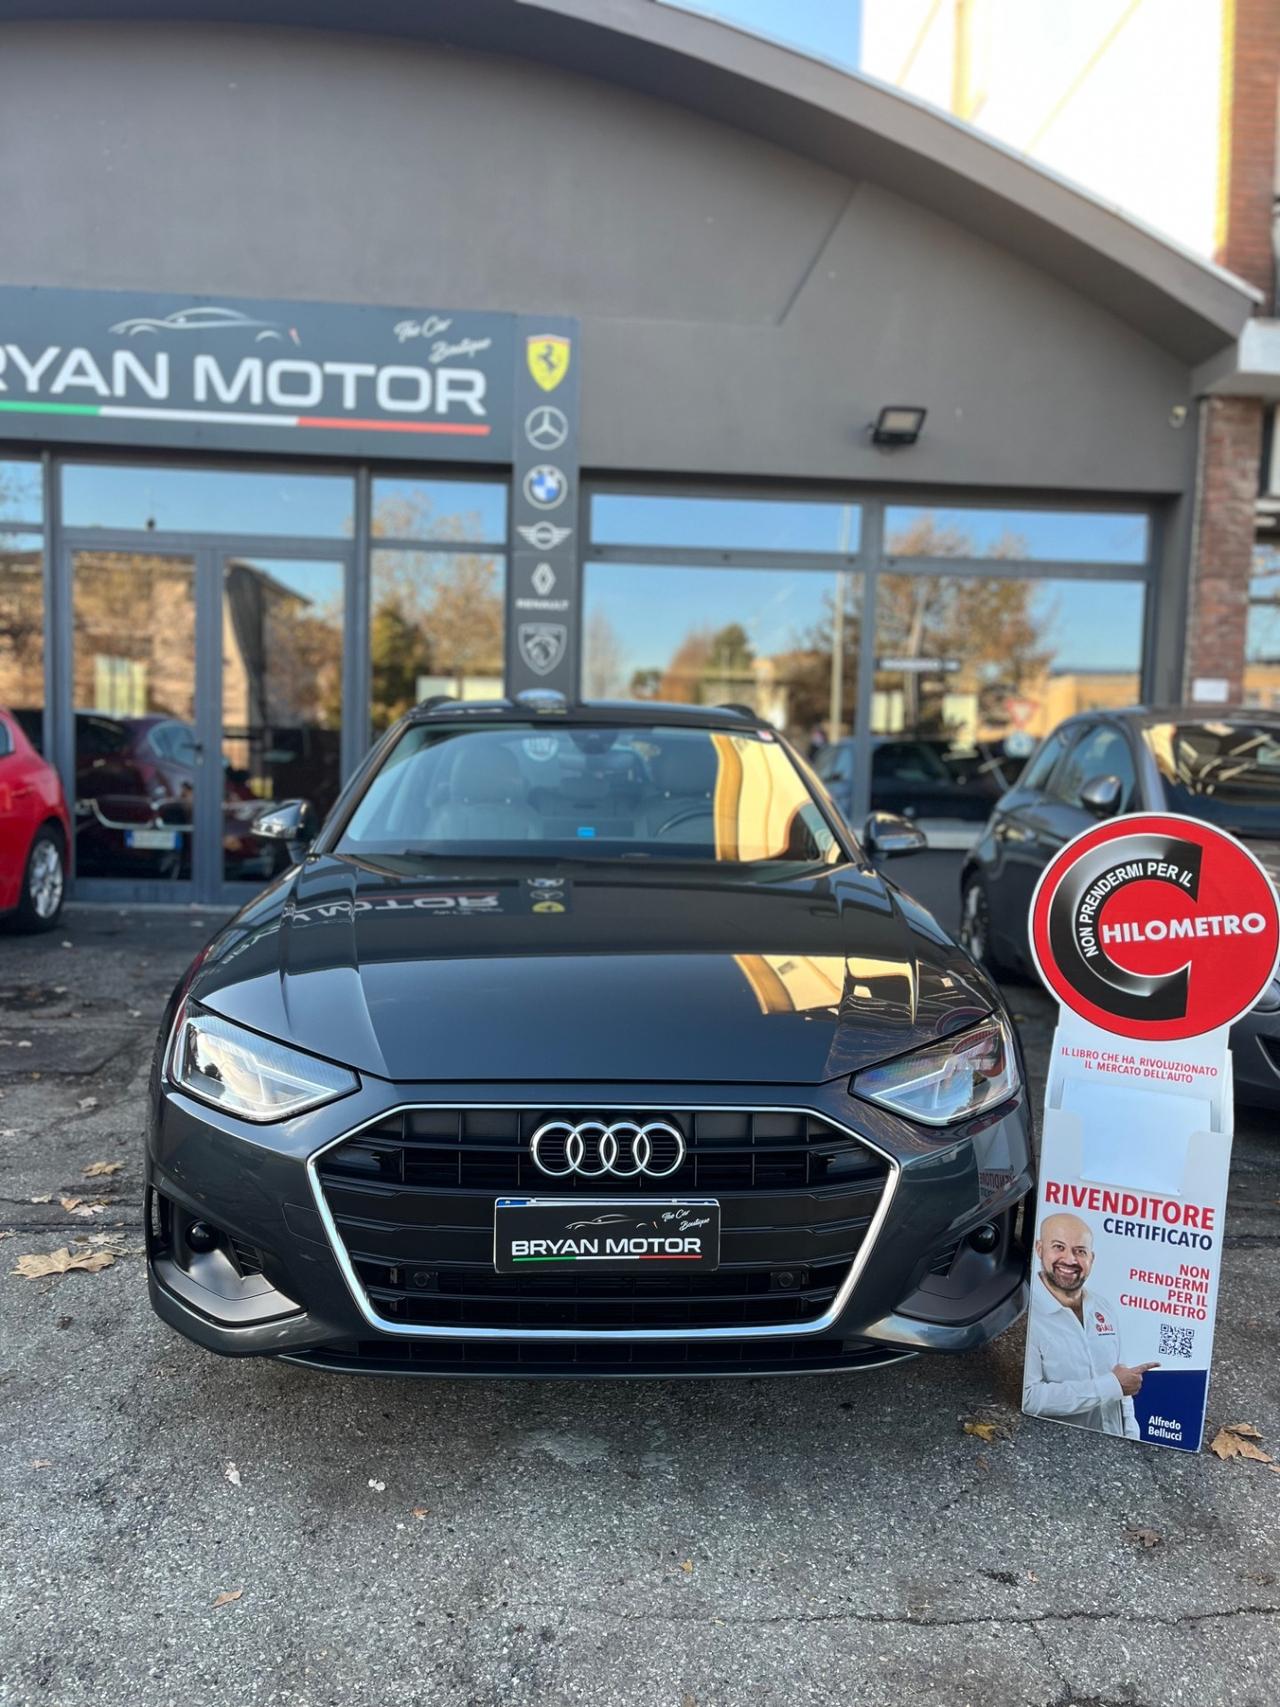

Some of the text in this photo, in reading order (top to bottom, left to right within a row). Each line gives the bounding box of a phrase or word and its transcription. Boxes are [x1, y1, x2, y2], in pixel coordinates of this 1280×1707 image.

[194, 353, 487, 416] MOTOR
[1079, 862, 1192, 958] NON PRENDERMI PER IL
[1061, 1046, 1218, 1077] IL LIBRO CHE HA RIVOLUZIONATO
[1084, 1060, 1193, 1084] IL MERCATO DELL'AUTO
[661, 1209, 690, 1223] The Car
[1045, 1181, 1216, 1231] RIVENDITORE
[678, 1216, 711, 1232] Boutique
[1103, 1218, 1213, 1251] CERTIFICATO
[511, 1237, 702, 1256] BRYAN MOTOR
[1129, 1268, 1209, 1294] PRENDERMI
[1179, 1263, 1210, 1281] NON
[1119, 1293, 1207, 1321] CHILOMETRO
[1168, 1289, 1208, 1308] PER IL
[1148, 1415, 1182, 1430] Alfredo
[1148, 1426, 1183, 1441] Bellucci
